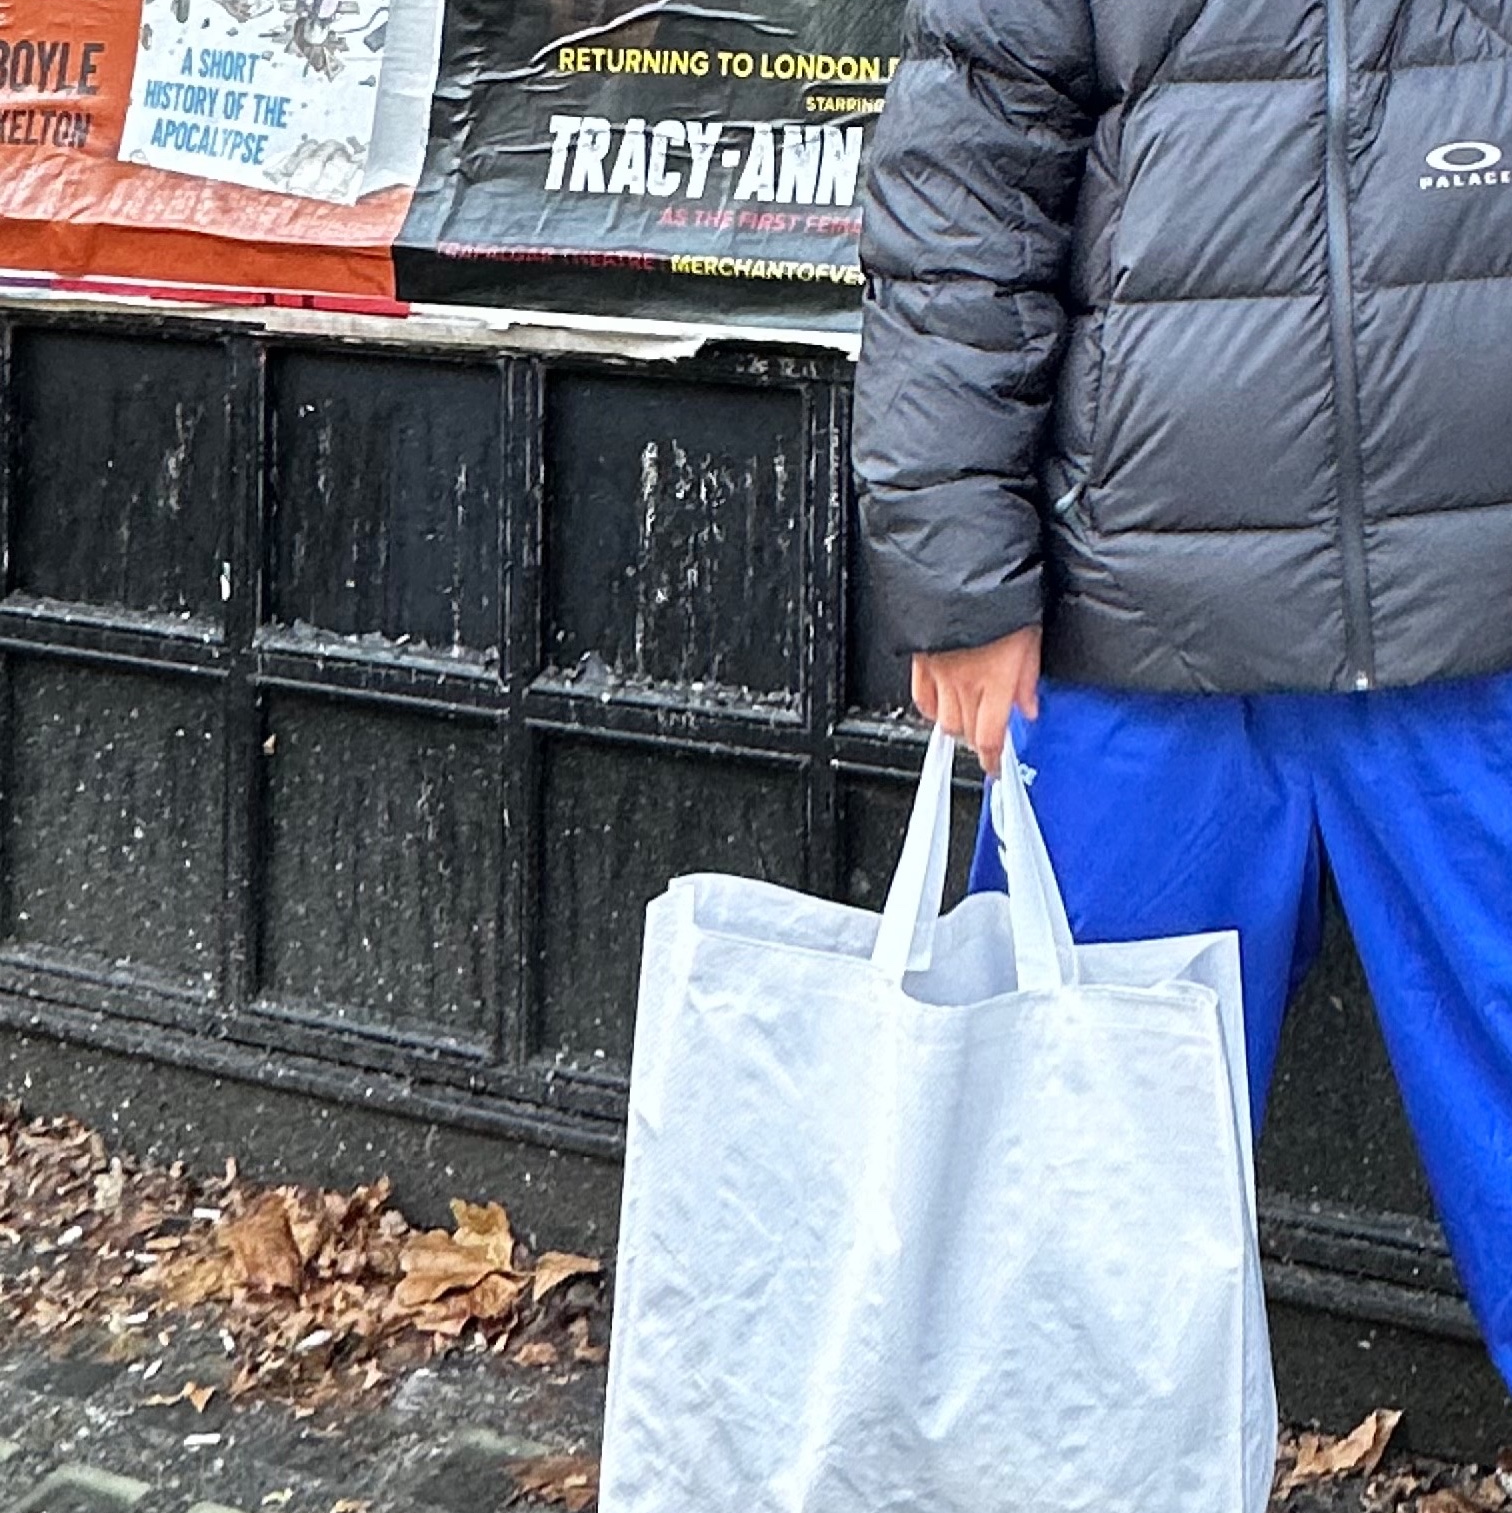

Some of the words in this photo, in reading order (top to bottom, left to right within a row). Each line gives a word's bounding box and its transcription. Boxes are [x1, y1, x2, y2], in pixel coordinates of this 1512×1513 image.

[180, 46, 193, 76] A
[198, 48, 260, 84] SHORT
[559, 47, 709, 77] RETURNING
[718, 52, 754, 78] TO
[760, 53, 880, 81] LONDON
[143, 79, 219, 117] HISTORY
[223, 90, 248, 121] OF
[253, 93, 291, 129] THE
[151, 117, 269, 165] APOCALYPSE
[545, 115, 864, 206] TRACY-ANN
[1419, 171, 1511, 189] PALACE
[660, 206, 688, 226] AS
[694, 210, 734, 230] THE
[738, 213, 799, 232] FIRST
